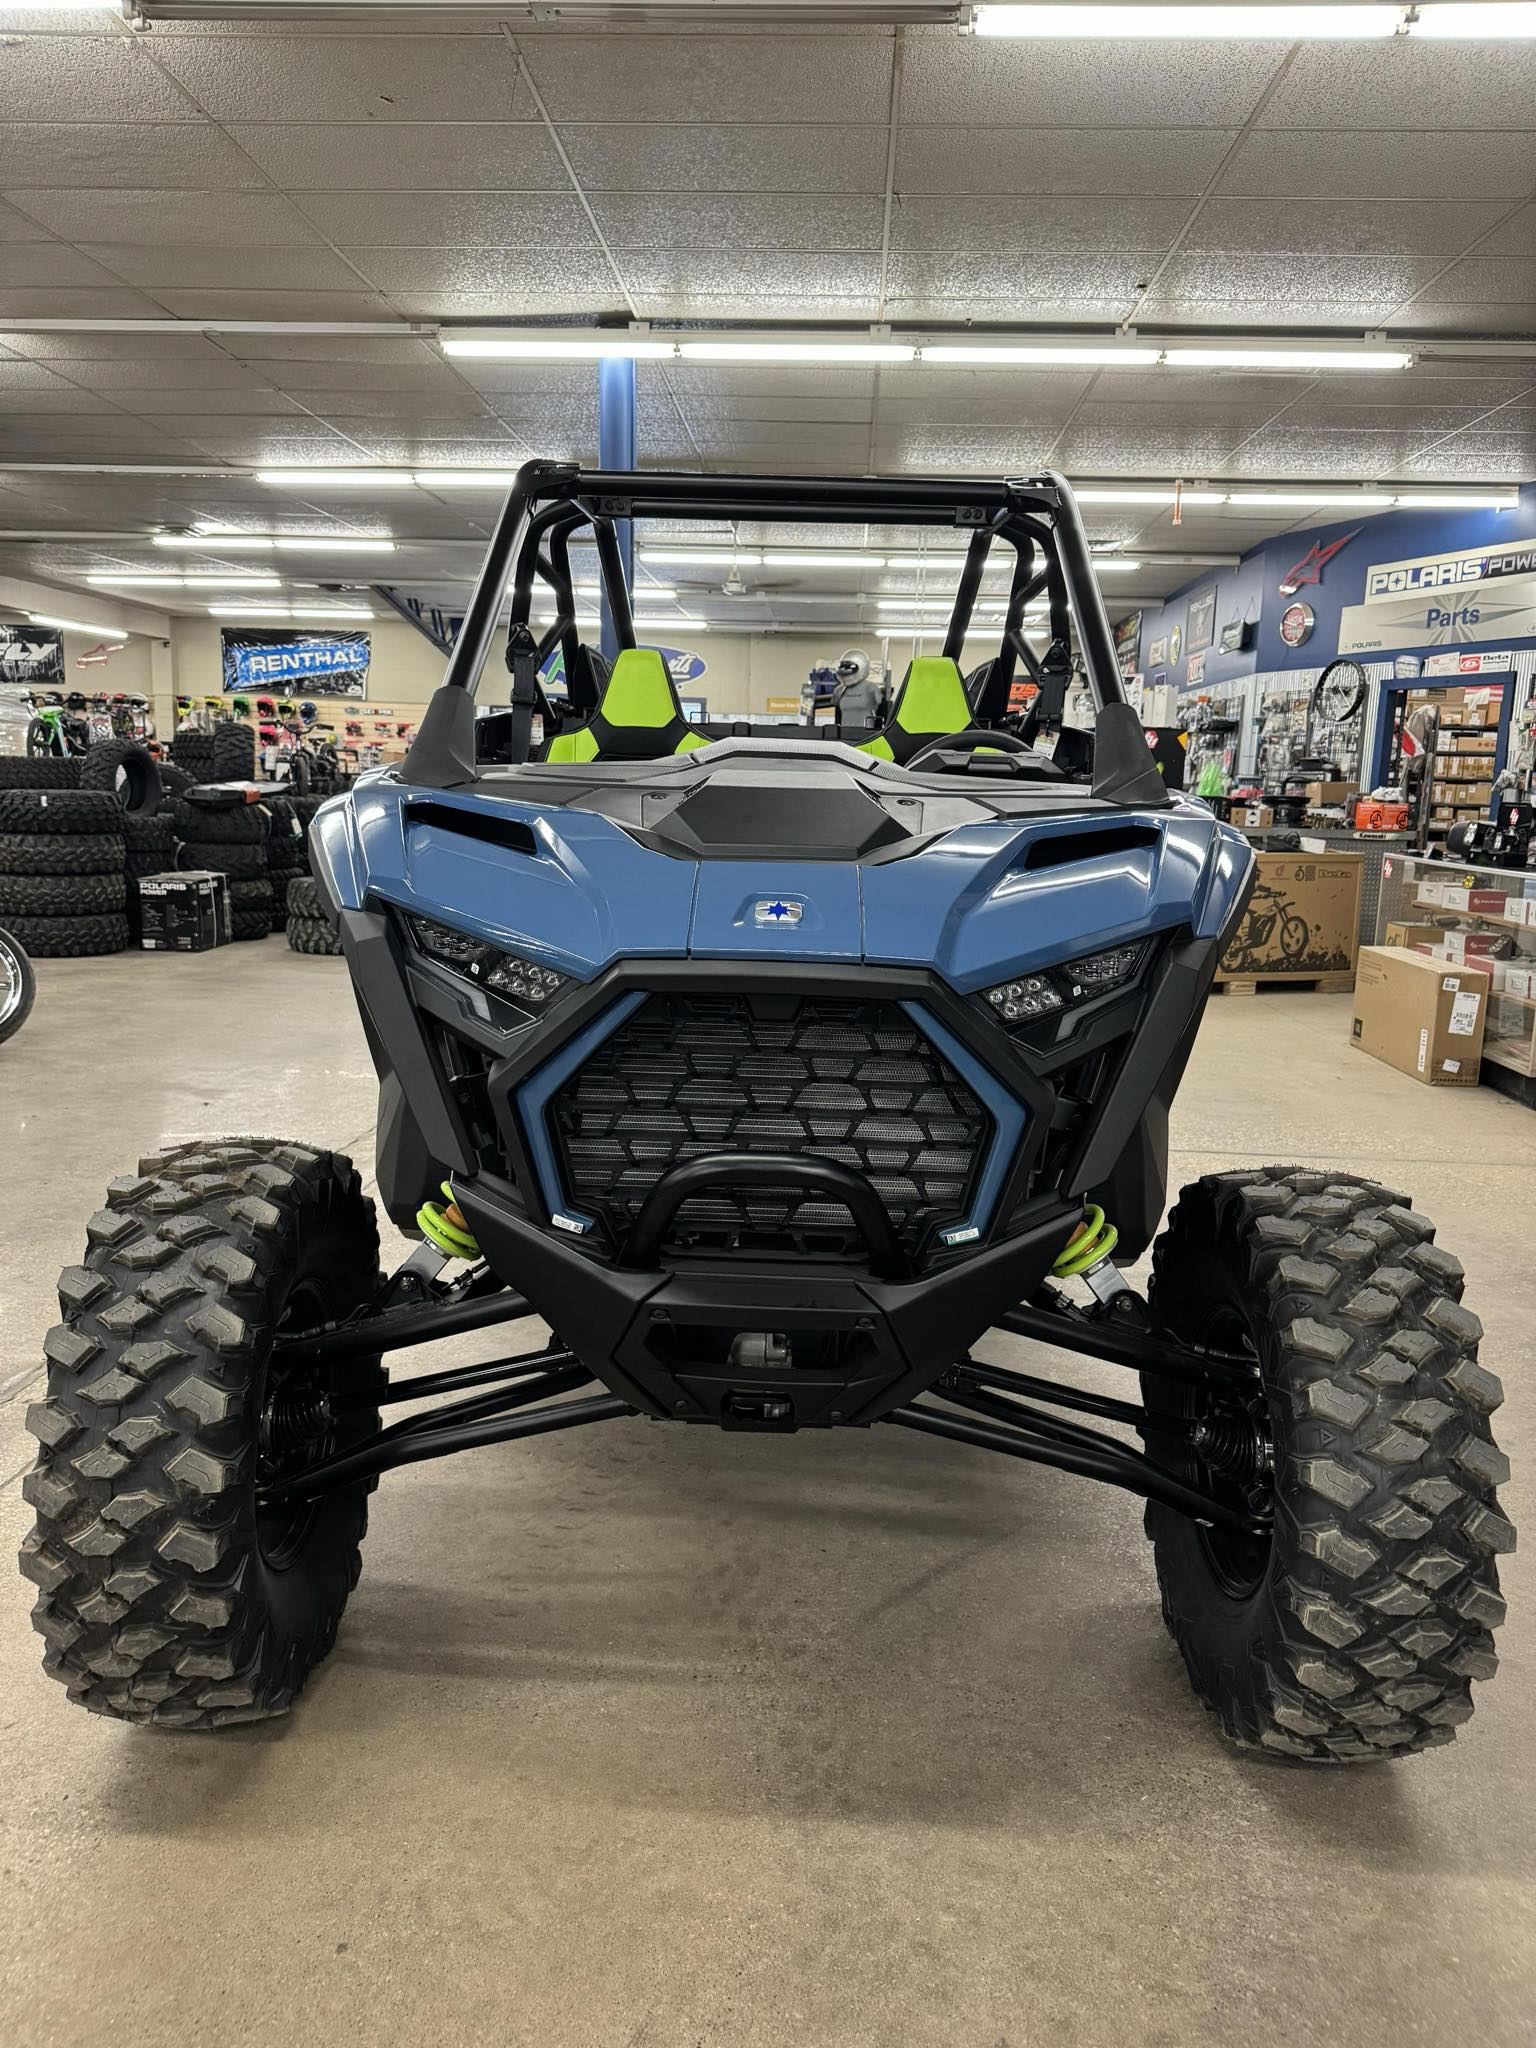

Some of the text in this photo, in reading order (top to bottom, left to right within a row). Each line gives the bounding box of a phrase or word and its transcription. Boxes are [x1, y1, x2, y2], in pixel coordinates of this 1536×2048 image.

[1370, 557, 1483, 595] POLARIS
[1426, 607, 1480, 629] Parts
[1352, 641, 1382, 649] POLARIS
[250, 650, 362, 674] RENTHAL
[140, 882, 187, 891] POLARIS
